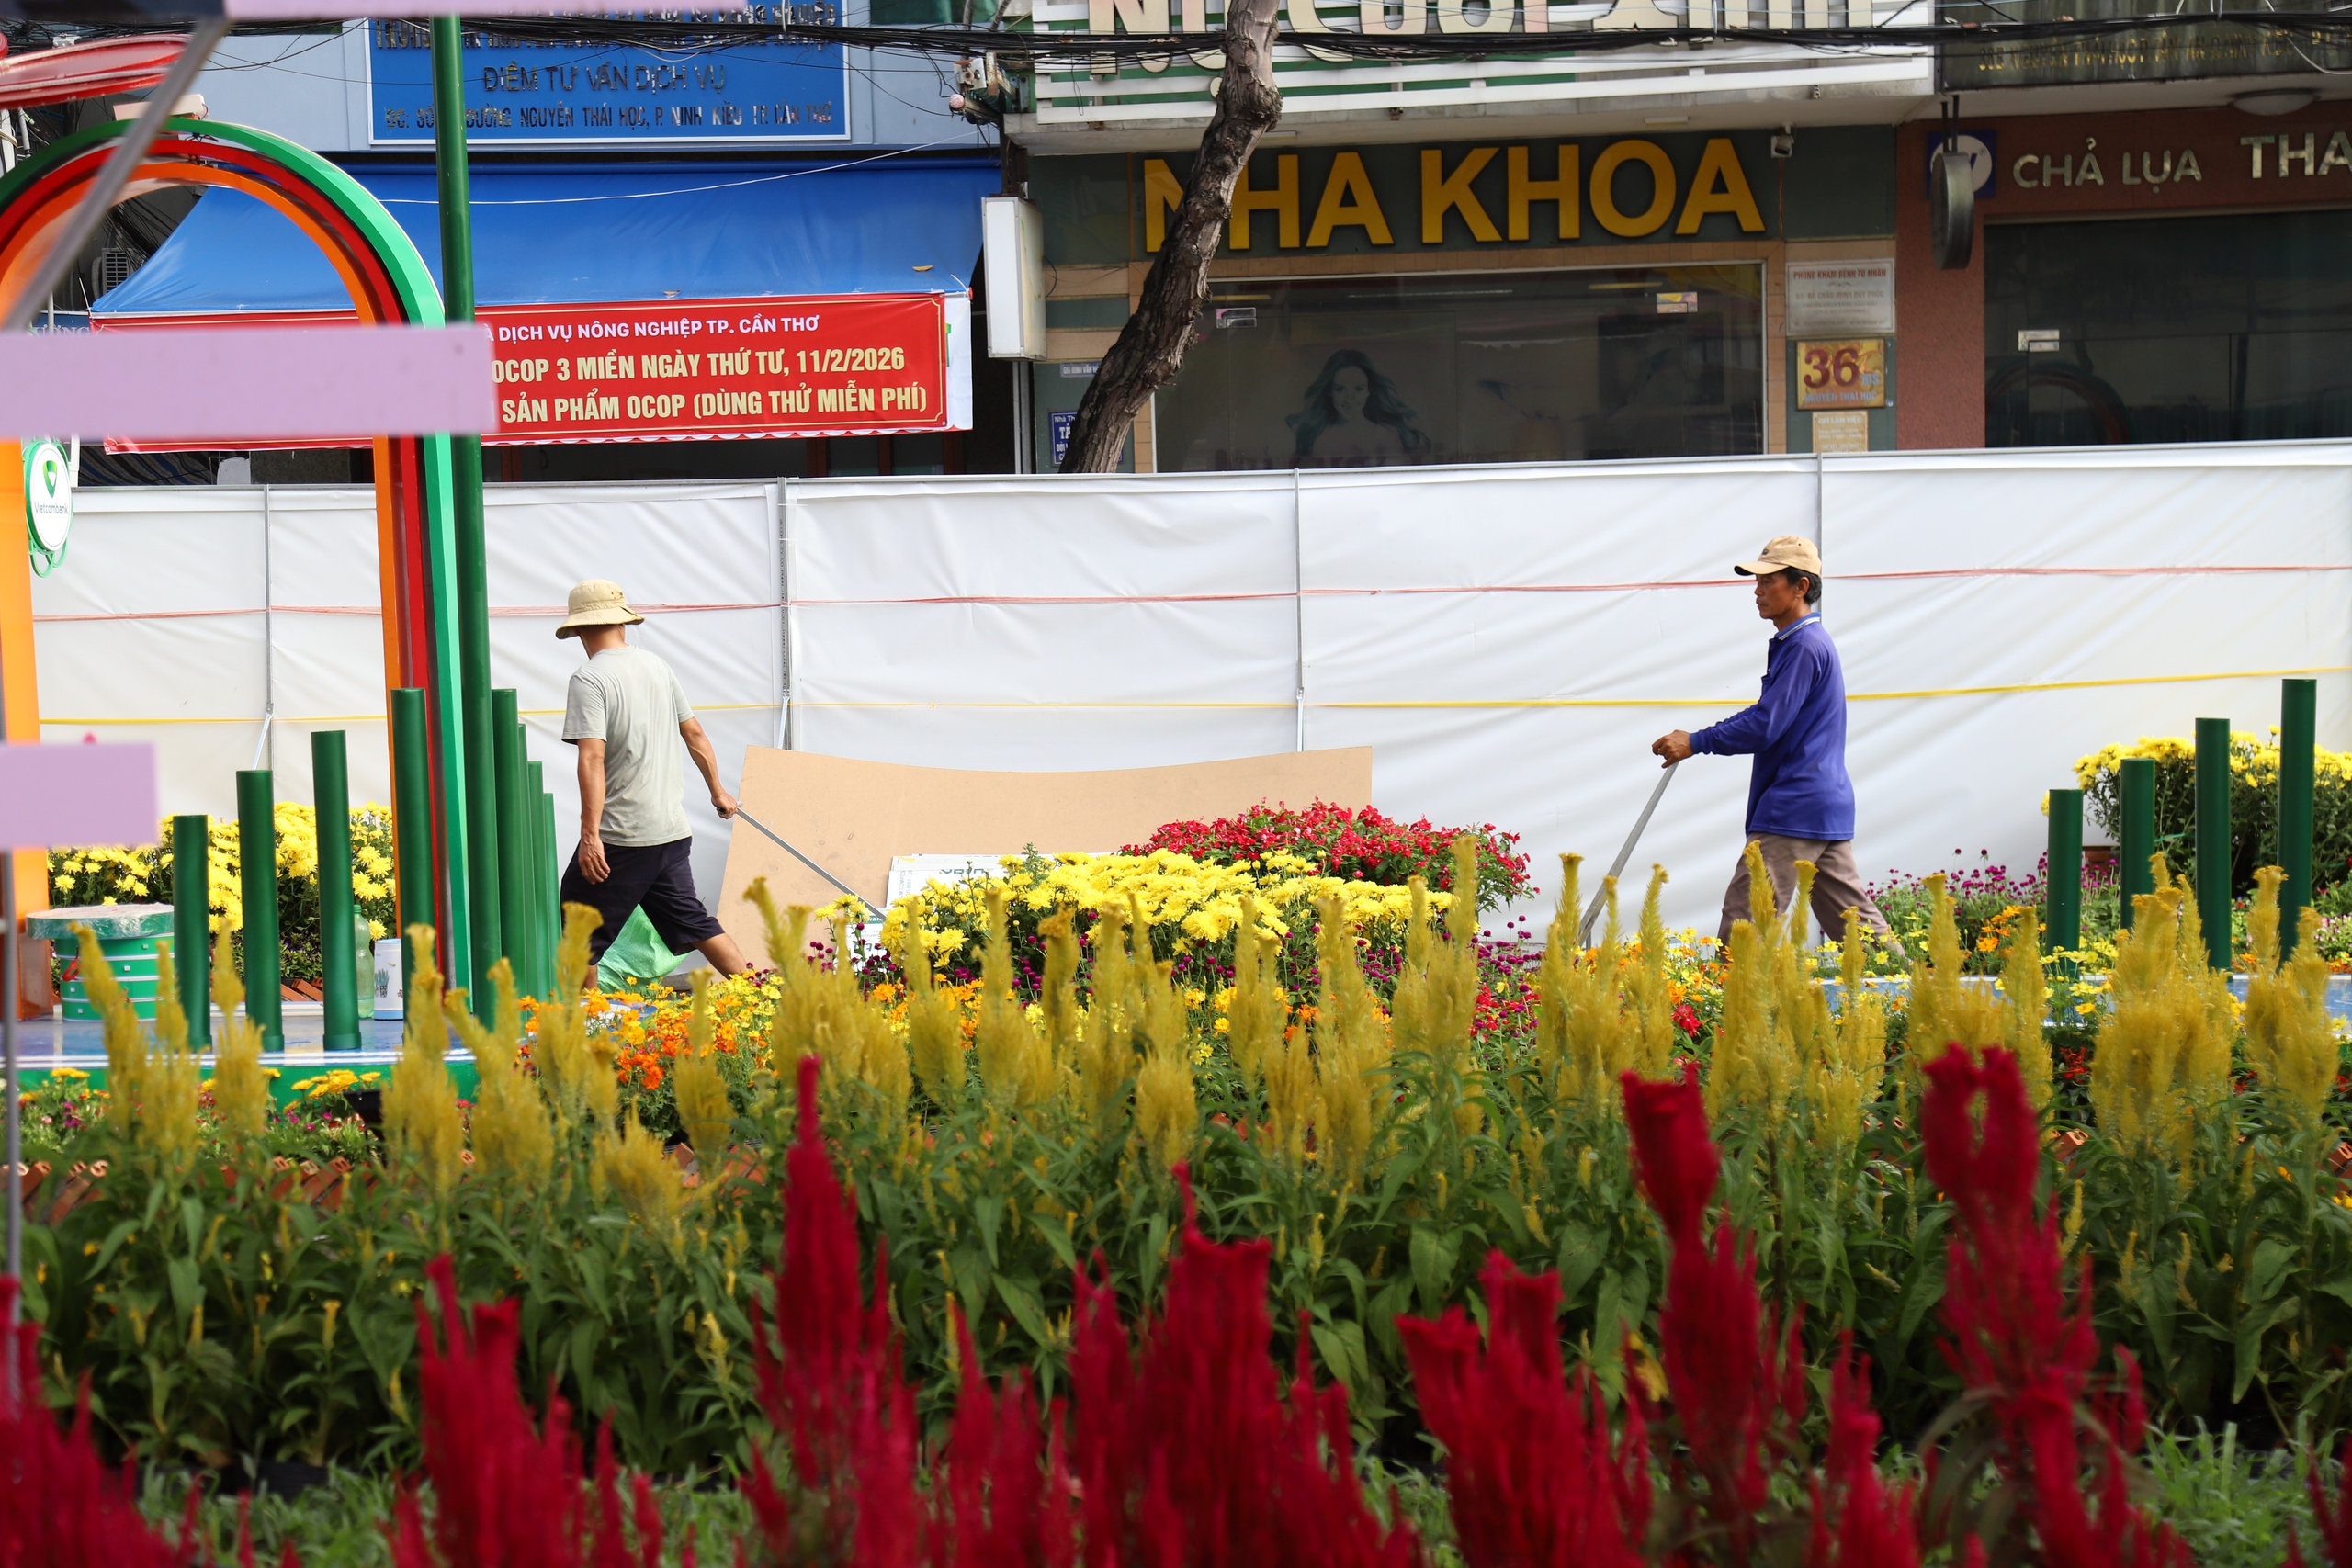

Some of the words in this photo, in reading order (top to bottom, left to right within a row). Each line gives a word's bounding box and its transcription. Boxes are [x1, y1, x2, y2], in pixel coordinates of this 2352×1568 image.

[483, 60, 538, 91] ĐIỂM
[586, 60, 628, 91] VẤN
[636, 64, 687, 95] DỊCH
[695, 64, 726, 94] VỤ
[582, 102, 613, 127] THÁI
[671, 106, 703, 127] NINH
[2013, 137, 2104, 188] CHẢ
[2122, 148, 2202, 194] LỤA
[1420, 137, 1766, 243] KHOA
[498, 325, 543, 344] DỊCH
[548, 324, 572, 343] VỤ
[578, 321, 629, 339] NÔNG
[634, 317, 702, 339] NGHIỆP
[706, 319, 735, 334] TP.
[739, 312, 776, 333] CẦN
[781, 314, 820, 332] THƠ
[491, 358, 550, 384] OCOP
[556, 357, 571, 382] 3
[576, 348, 635, 380] MIỀN
[640, 349, 701, 378] NGÀY
[707, 346, 752, 377] THỨ
[755, 348, 790, 377] TƯ,
[797, 346, 905, 374] 11/2/2026
[1804, 347, 1860, 389] 36
[1861, 372, 1880, 386] BIS
[502, 391, 548, 423] SẢN
[554, 387, 620, 422] PHẨM
[627, 394, 685, 420] OCOP
[694, 388, 763, 419] (DÙNG
[768, 382, 812, 414] THỬ
[817, 379, 875, 412] MIỄN
[882, 381, 927, 412] PHÍ)
